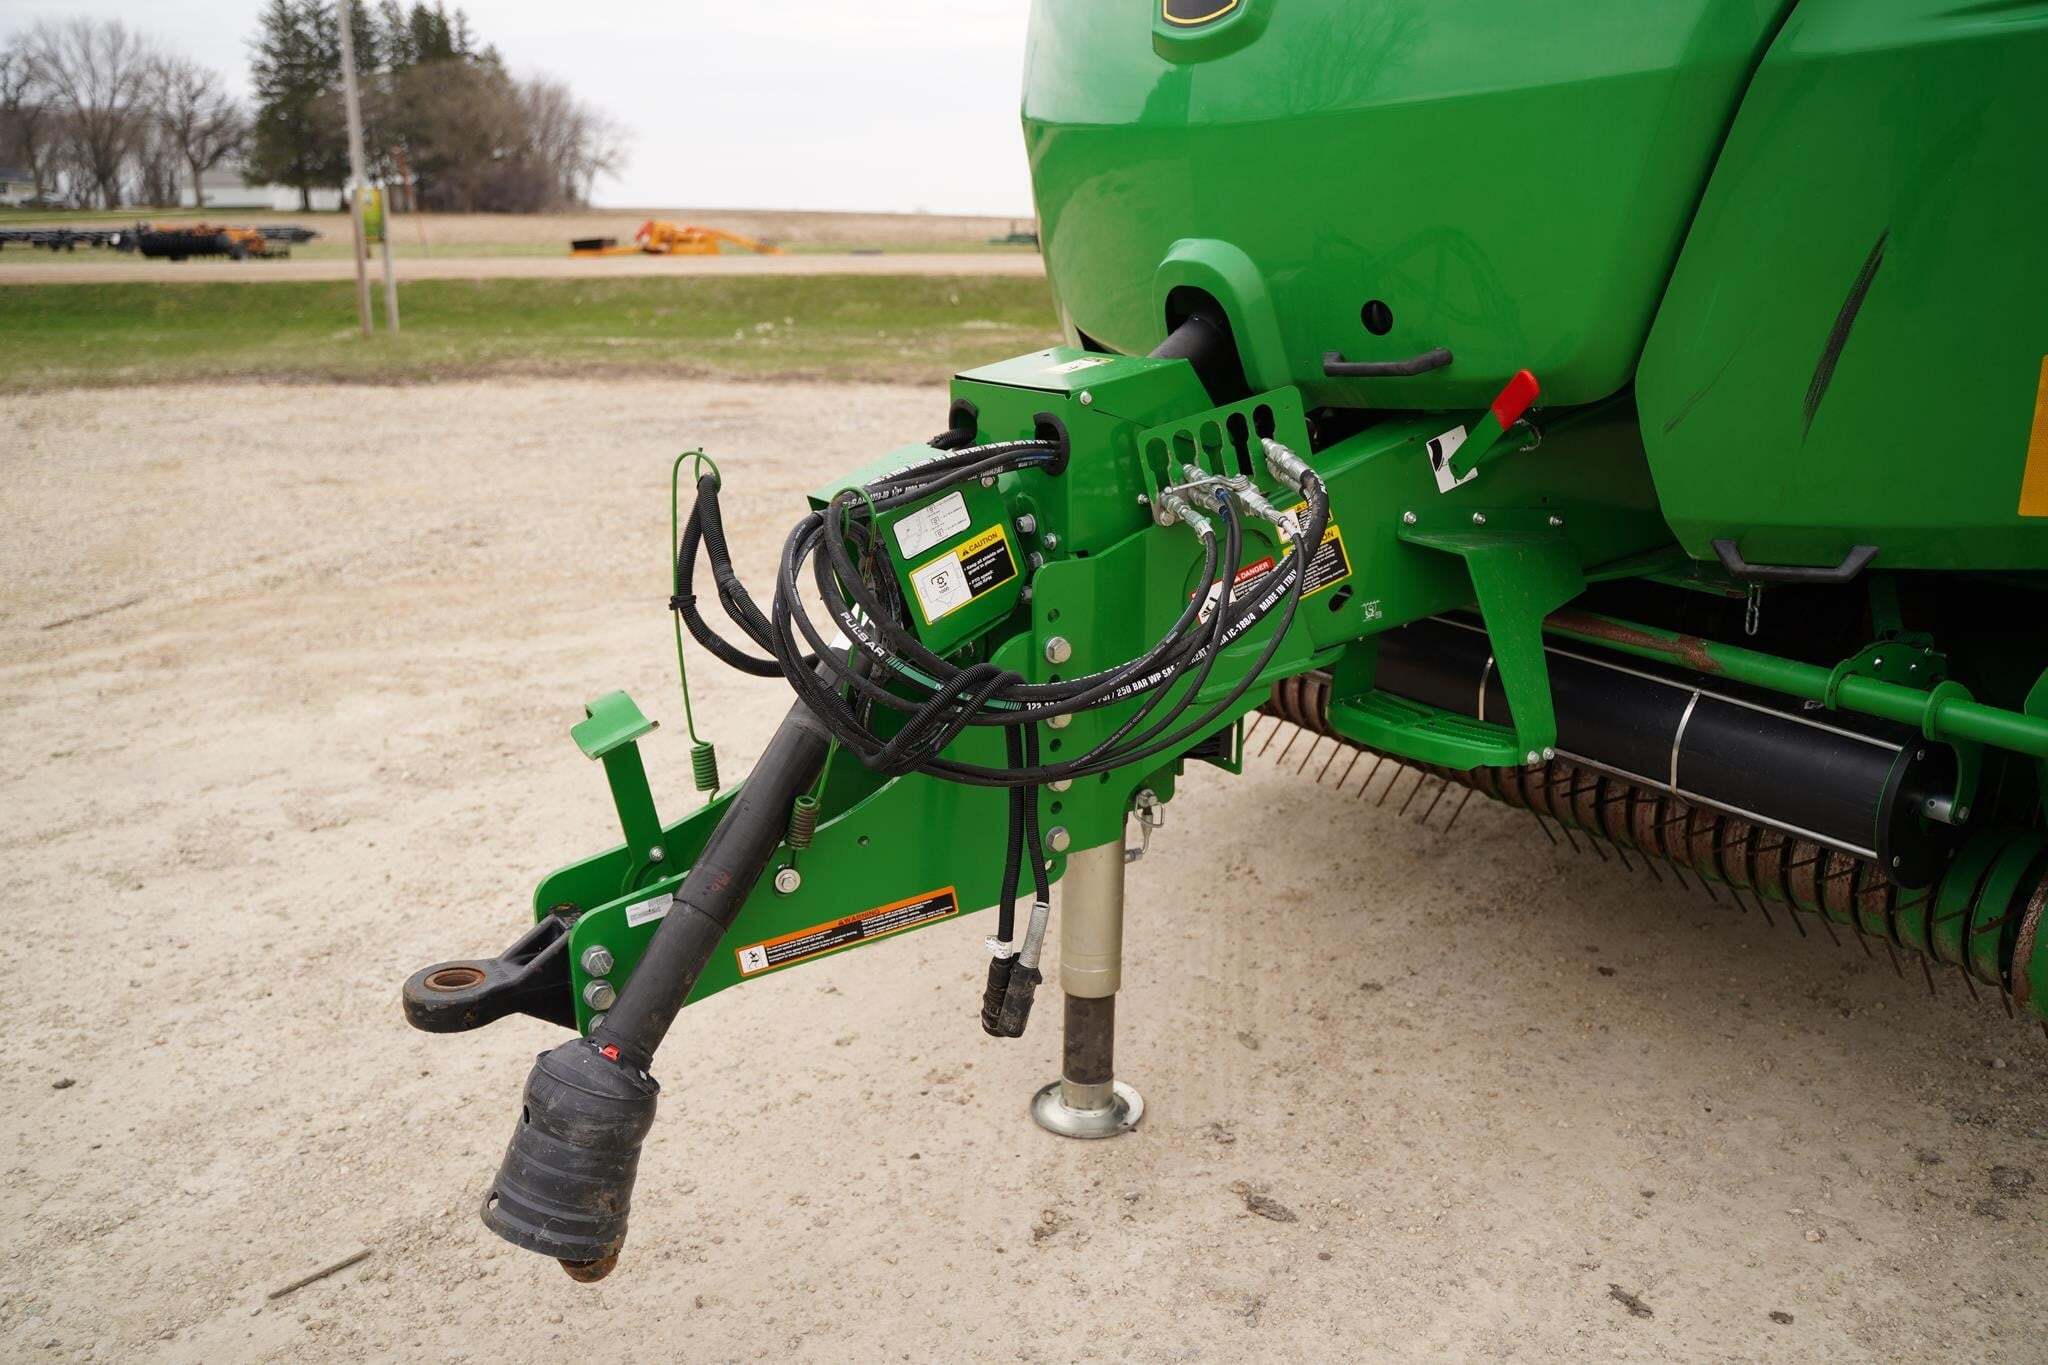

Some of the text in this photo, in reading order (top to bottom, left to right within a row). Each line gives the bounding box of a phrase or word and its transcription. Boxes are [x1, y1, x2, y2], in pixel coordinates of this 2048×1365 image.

[968, 532, 998, 552] CAUTION
[1240, 561, 1269, 580] DANGER
[840, 611, 886, 658] PULSAR
[1116, 685, 1132, 697] 250
[1132, 678, 1149, 692] BAR
[1148, 672, 1162, 685] WP
[1258, 591, 1279, 612] MADE
[1276, 585, 1286, 596] IN
[844, 907, 881, 924] WARNING
